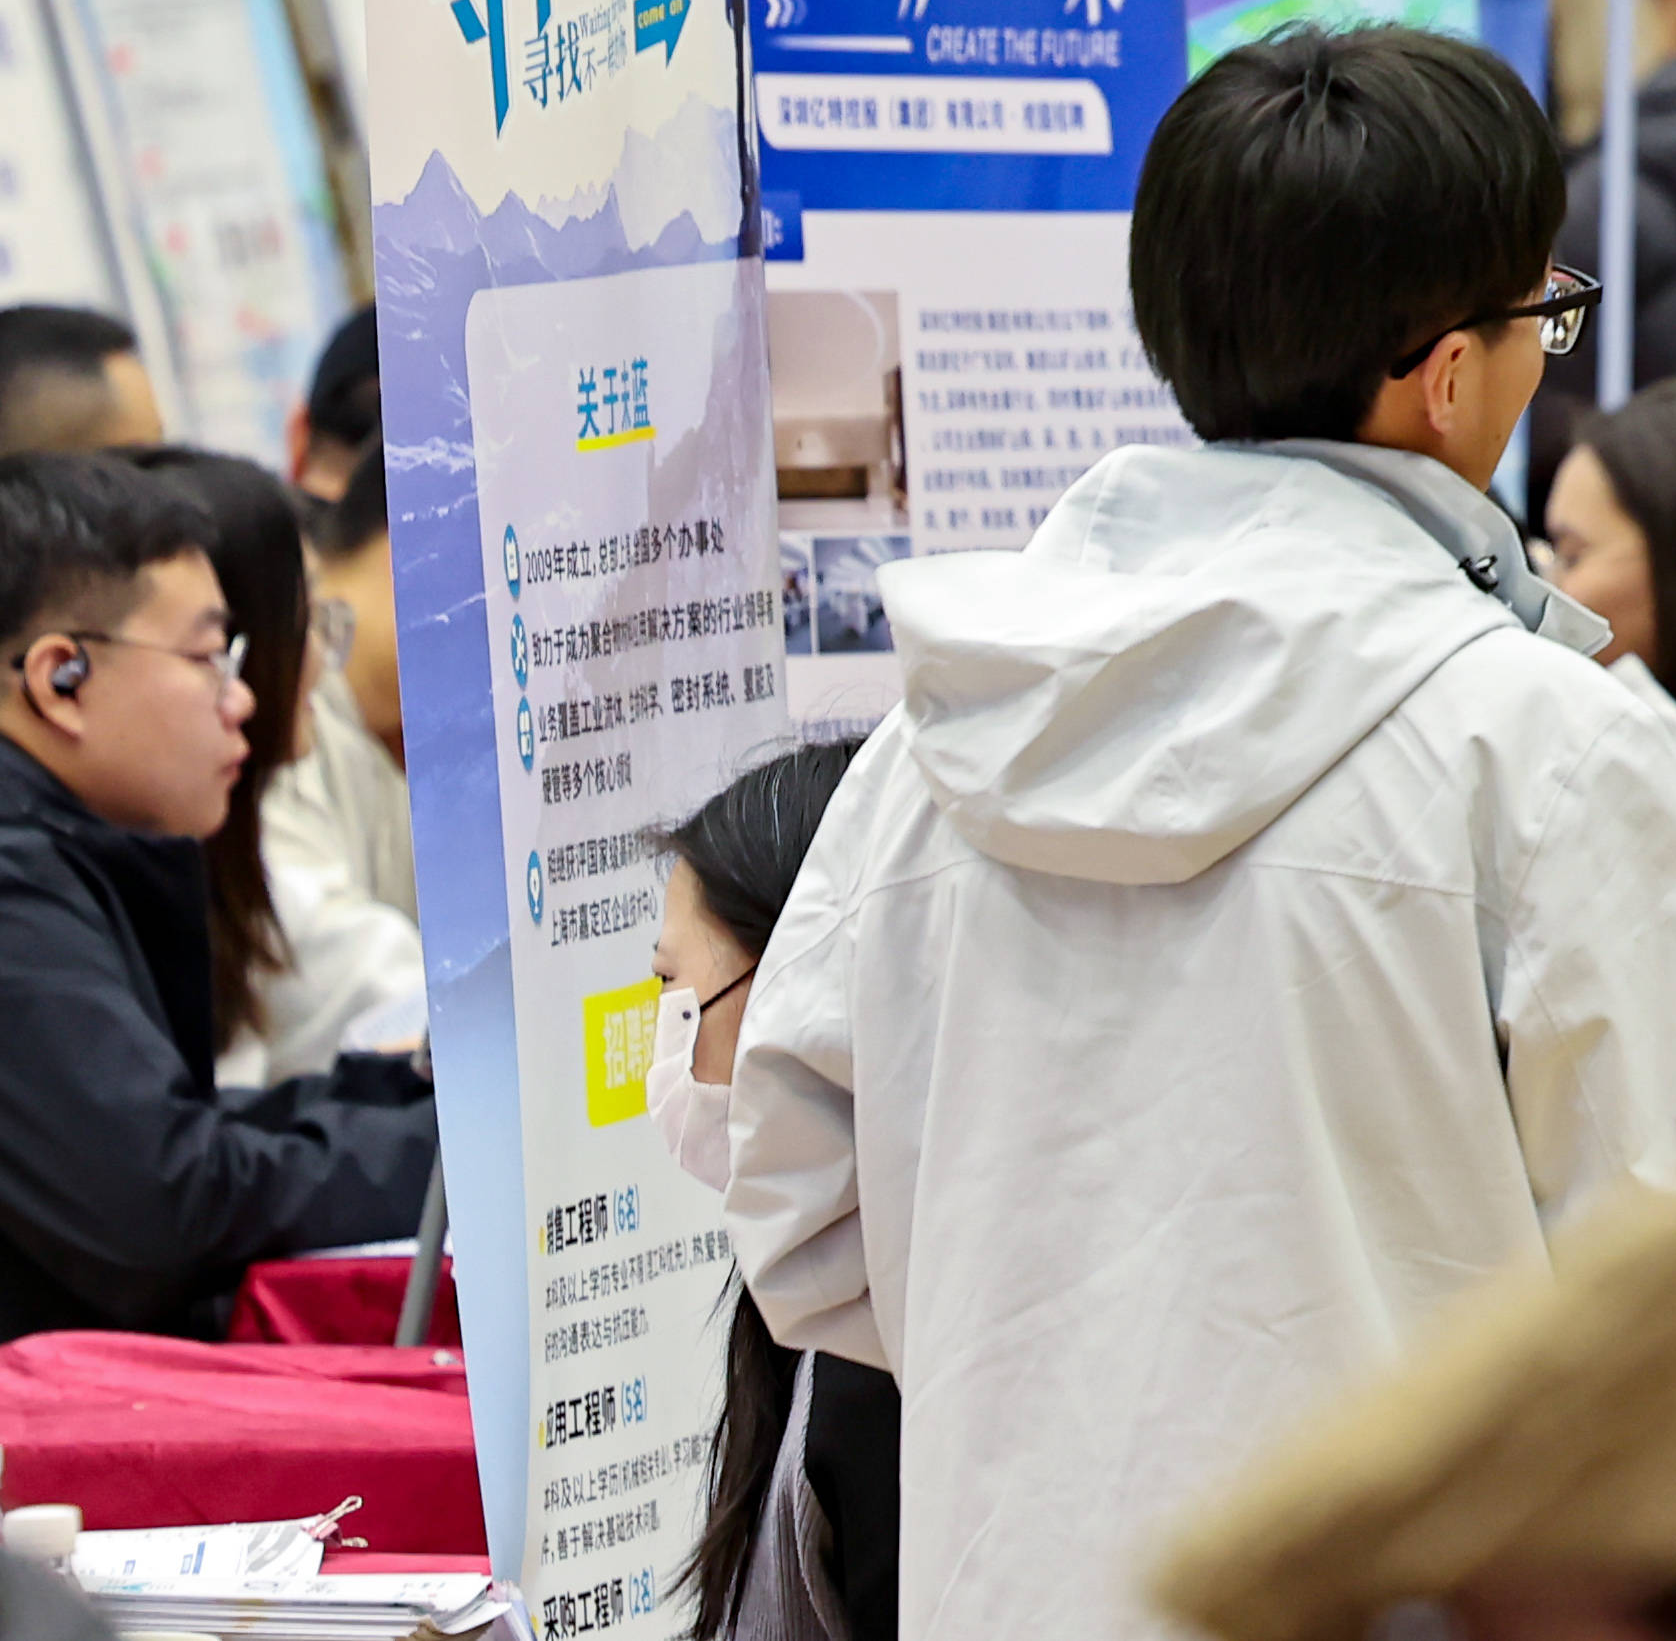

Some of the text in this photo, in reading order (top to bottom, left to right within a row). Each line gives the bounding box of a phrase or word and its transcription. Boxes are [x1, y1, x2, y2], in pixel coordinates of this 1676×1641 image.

[522, 21, 582, 109] 寻找
[926, 24, 1121, 68] CREATE THE FUTURE
[577, 357, 650, 439] 关于未蓝
